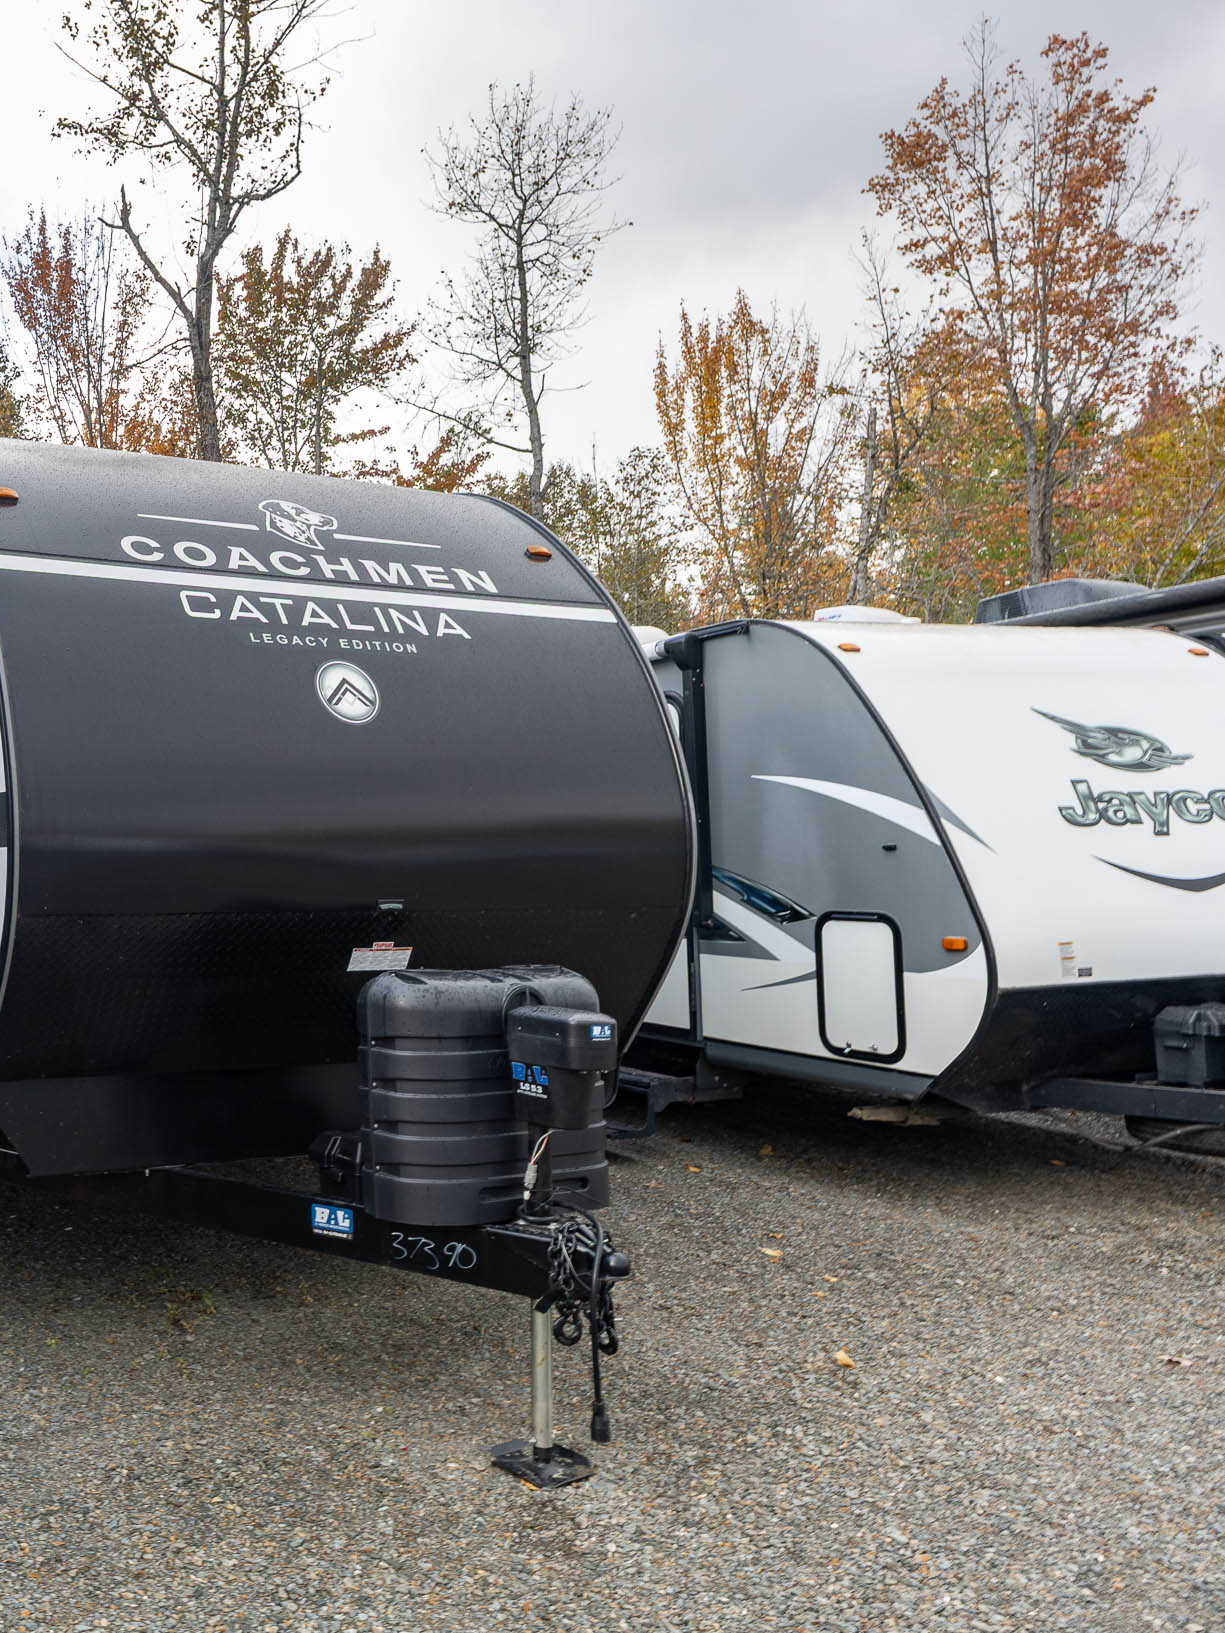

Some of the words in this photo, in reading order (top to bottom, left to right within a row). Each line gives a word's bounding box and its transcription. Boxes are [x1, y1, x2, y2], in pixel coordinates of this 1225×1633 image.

[120, 535, 498, 593] COACHMEN
[180, 590, 472, 640] CATALINA
[249, 632, 329, 648] LEGACY
[339, 639, 418, 654] EDITION
